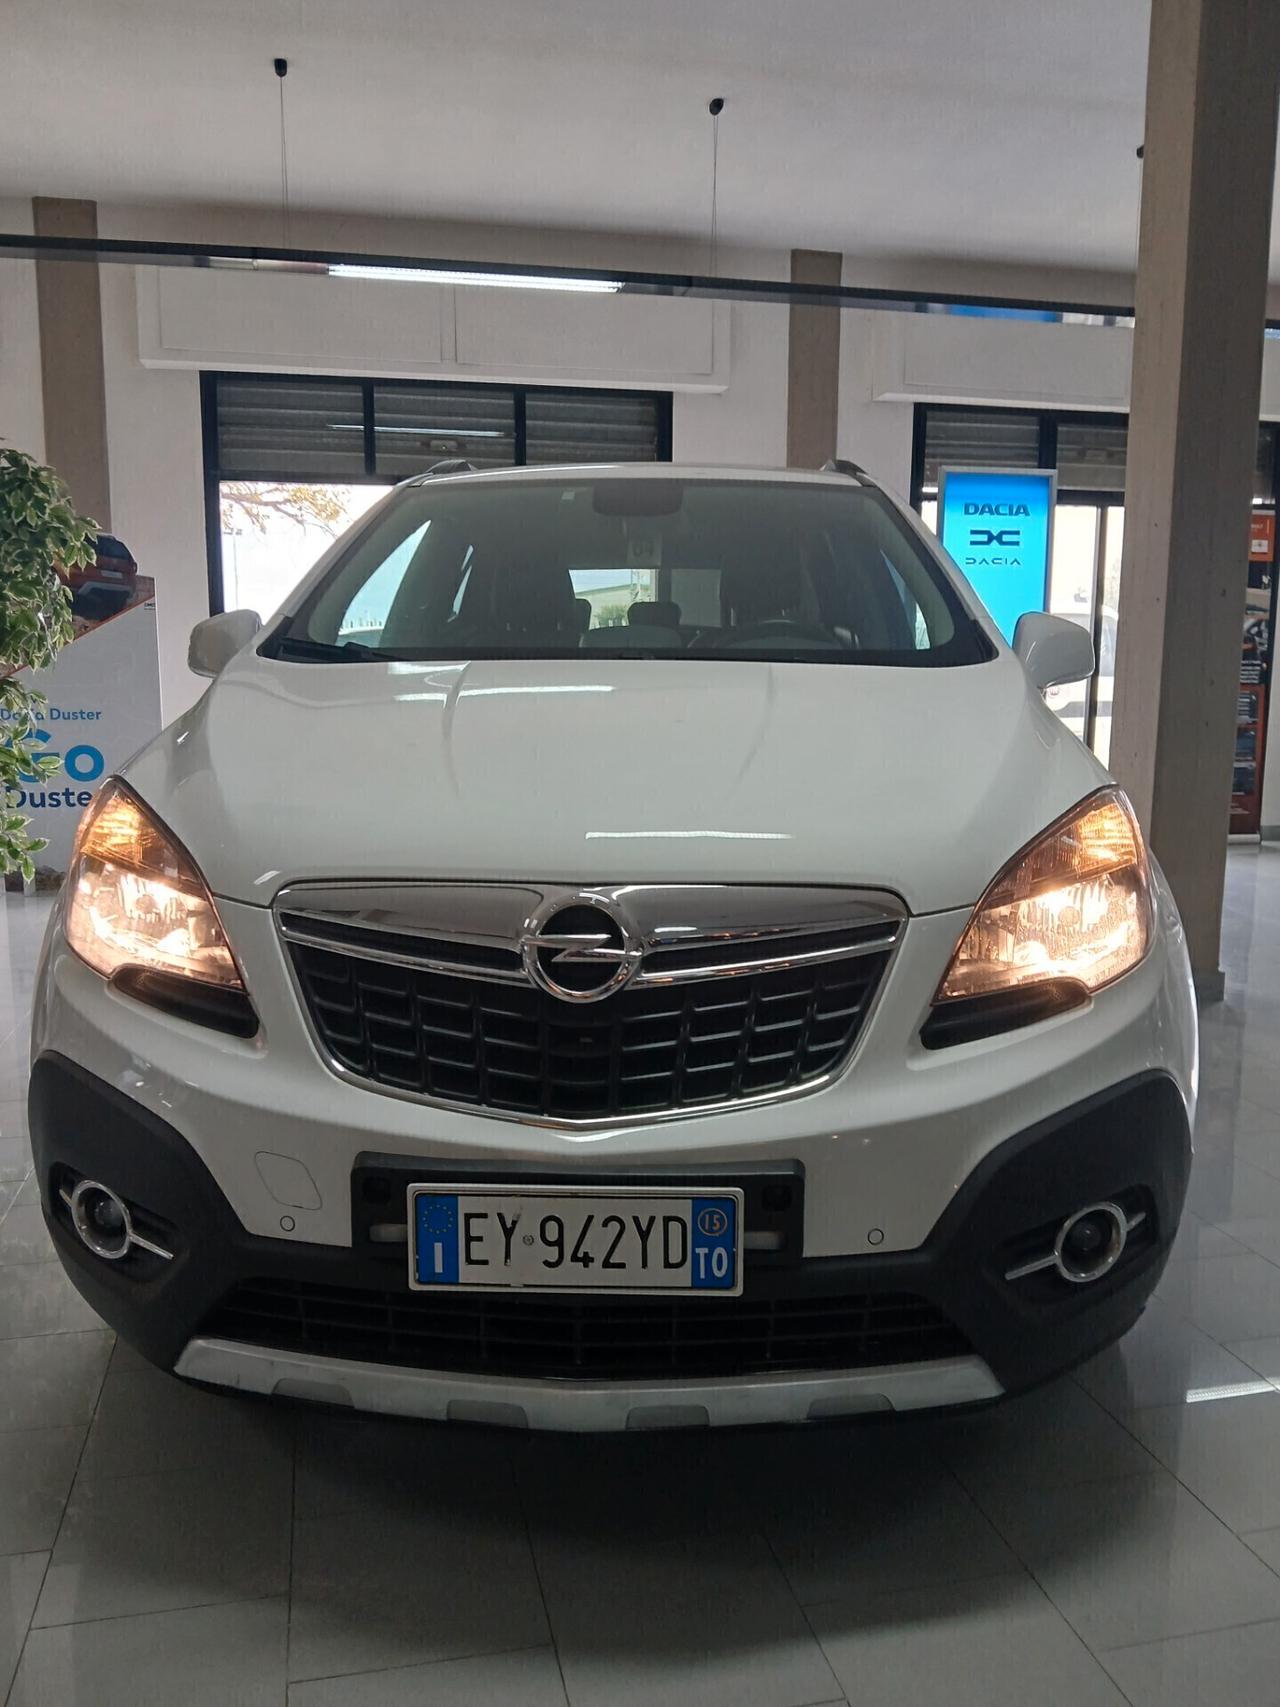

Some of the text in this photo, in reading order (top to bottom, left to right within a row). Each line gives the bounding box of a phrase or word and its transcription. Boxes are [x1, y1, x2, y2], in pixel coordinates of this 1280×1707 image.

[964, 503, 1030, 516] DACIA
[965, 557, 1021, 565] DACIA
[1, 708, 101, 720] Daa Duster
[705, 1214, 721, 1231] 15
[464, 1211, 689, 1270] EY 942YD
[695, 1247, 728, 1279] TO
